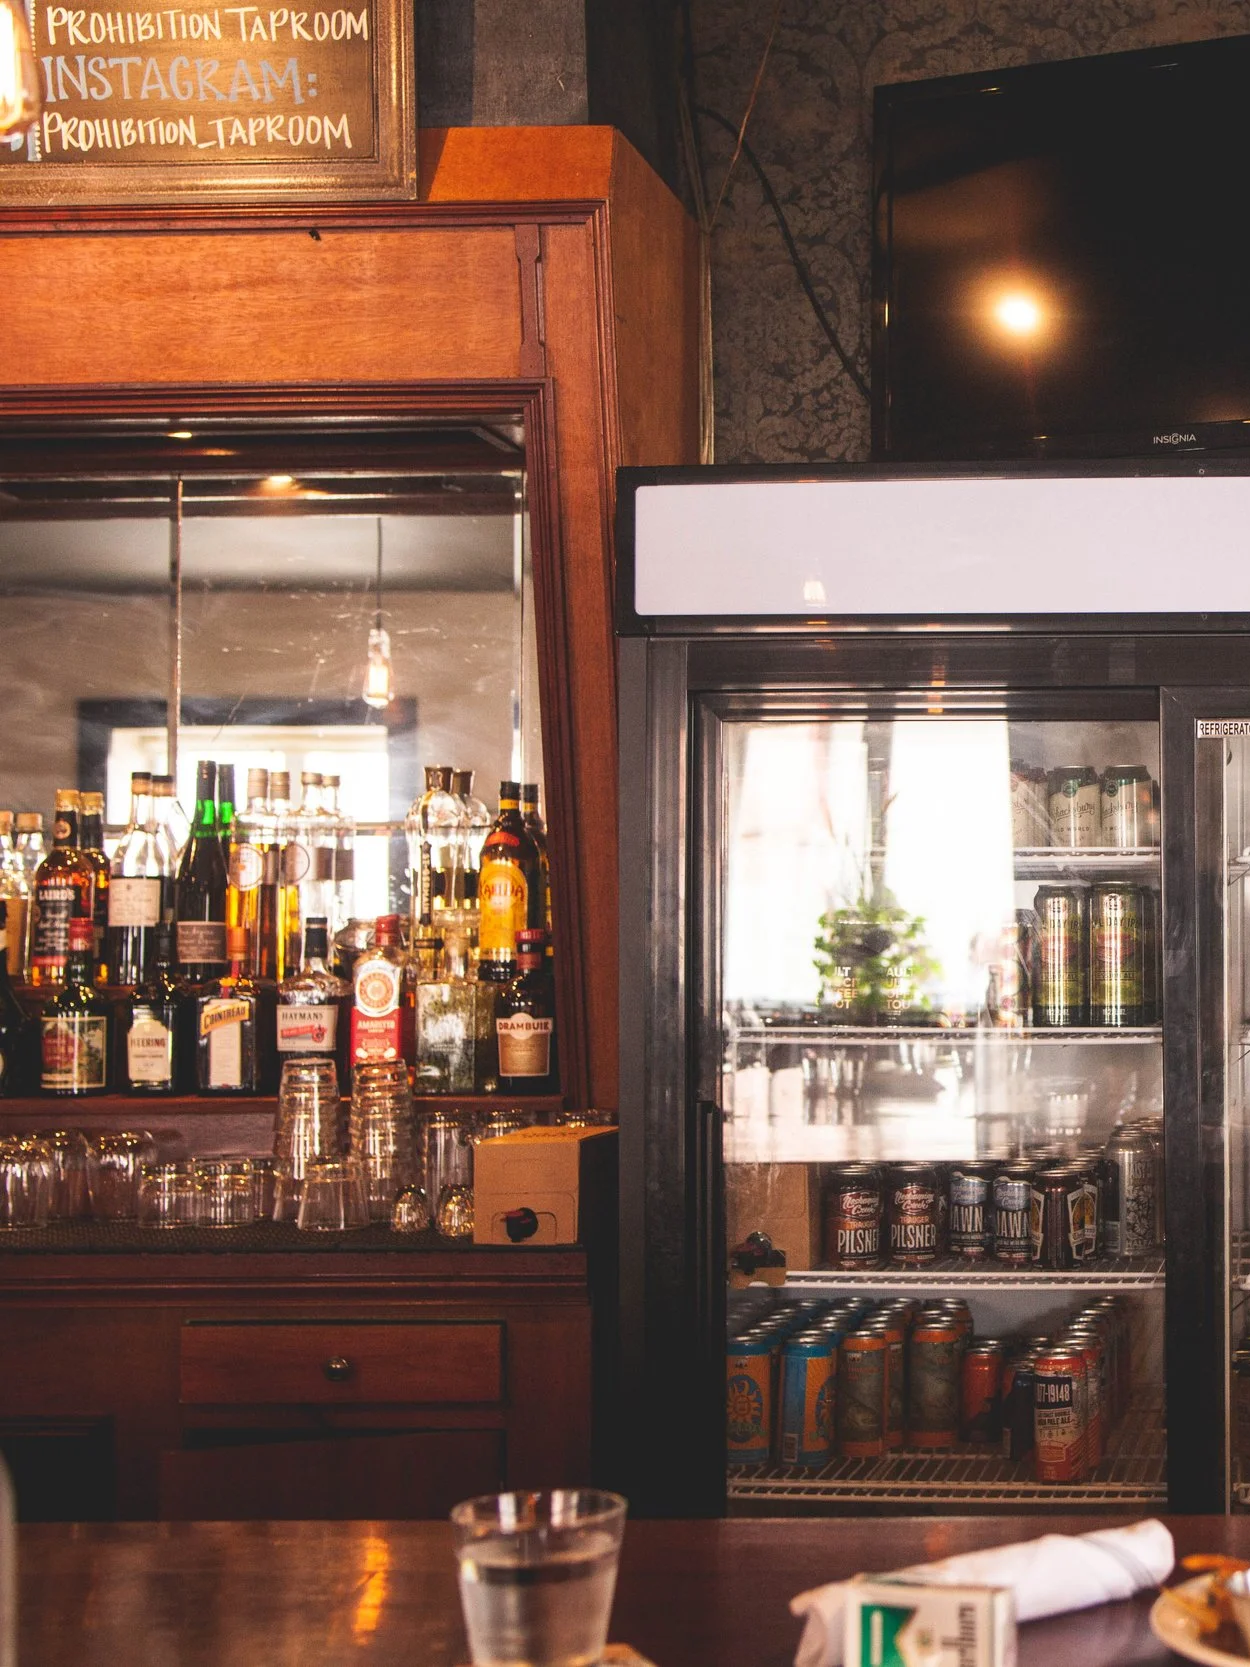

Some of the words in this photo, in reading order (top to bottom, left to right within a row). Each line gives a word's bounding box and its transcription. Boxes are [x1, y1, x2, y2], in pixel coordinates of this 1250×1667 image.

[47, 7, 222, 46] PROHIBITION
[225, 6, 369, 43] TAPROOM
[41, 55, 318, 105] INSTAGRAM:
[42, 112, 352, 151] PROHIBITION_TAPROOM
[1153, 433, 1197, 444] INSIGNIA
[204, 1008, 246, 1030] COINTREAU
[837, 1229, 879, 1254] PILSNE
[890, 1223, 937, 1249] PILSNER
